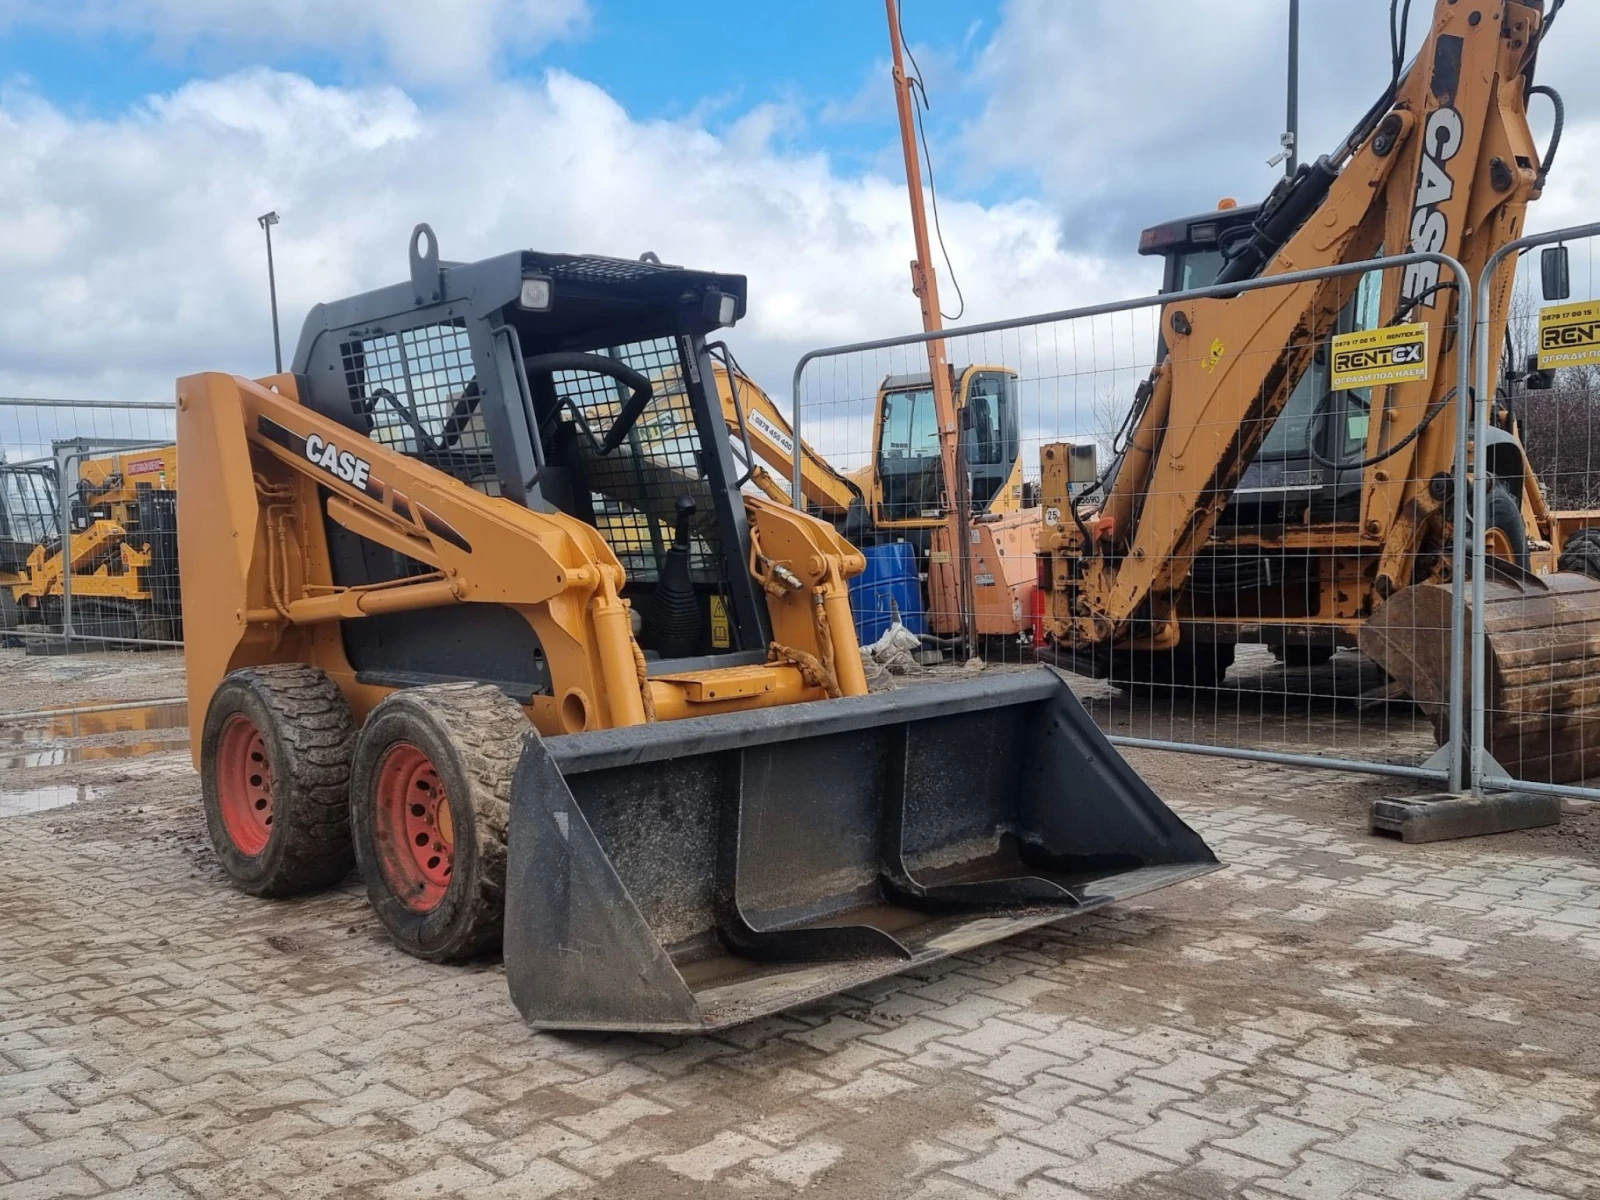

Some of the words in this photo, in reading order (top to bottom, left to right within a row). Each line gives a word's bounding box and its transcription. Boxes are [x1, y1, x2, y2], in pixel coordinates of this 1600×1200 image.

[1402, 107, 1463, 307] CASE
[1337, 345, 1421, 369] RENTEX
[1542, 351, 1587, 363] ОГРАДИ
[1335, 374, 1372, 385] ОГРАДИ
[1374, 371, 1393, 380] ПОД
[1395, 368, 1425, 378] НАЕМ
[305, 433, 371, 491] CASE
[1048, 510, 1058, 521] 25
